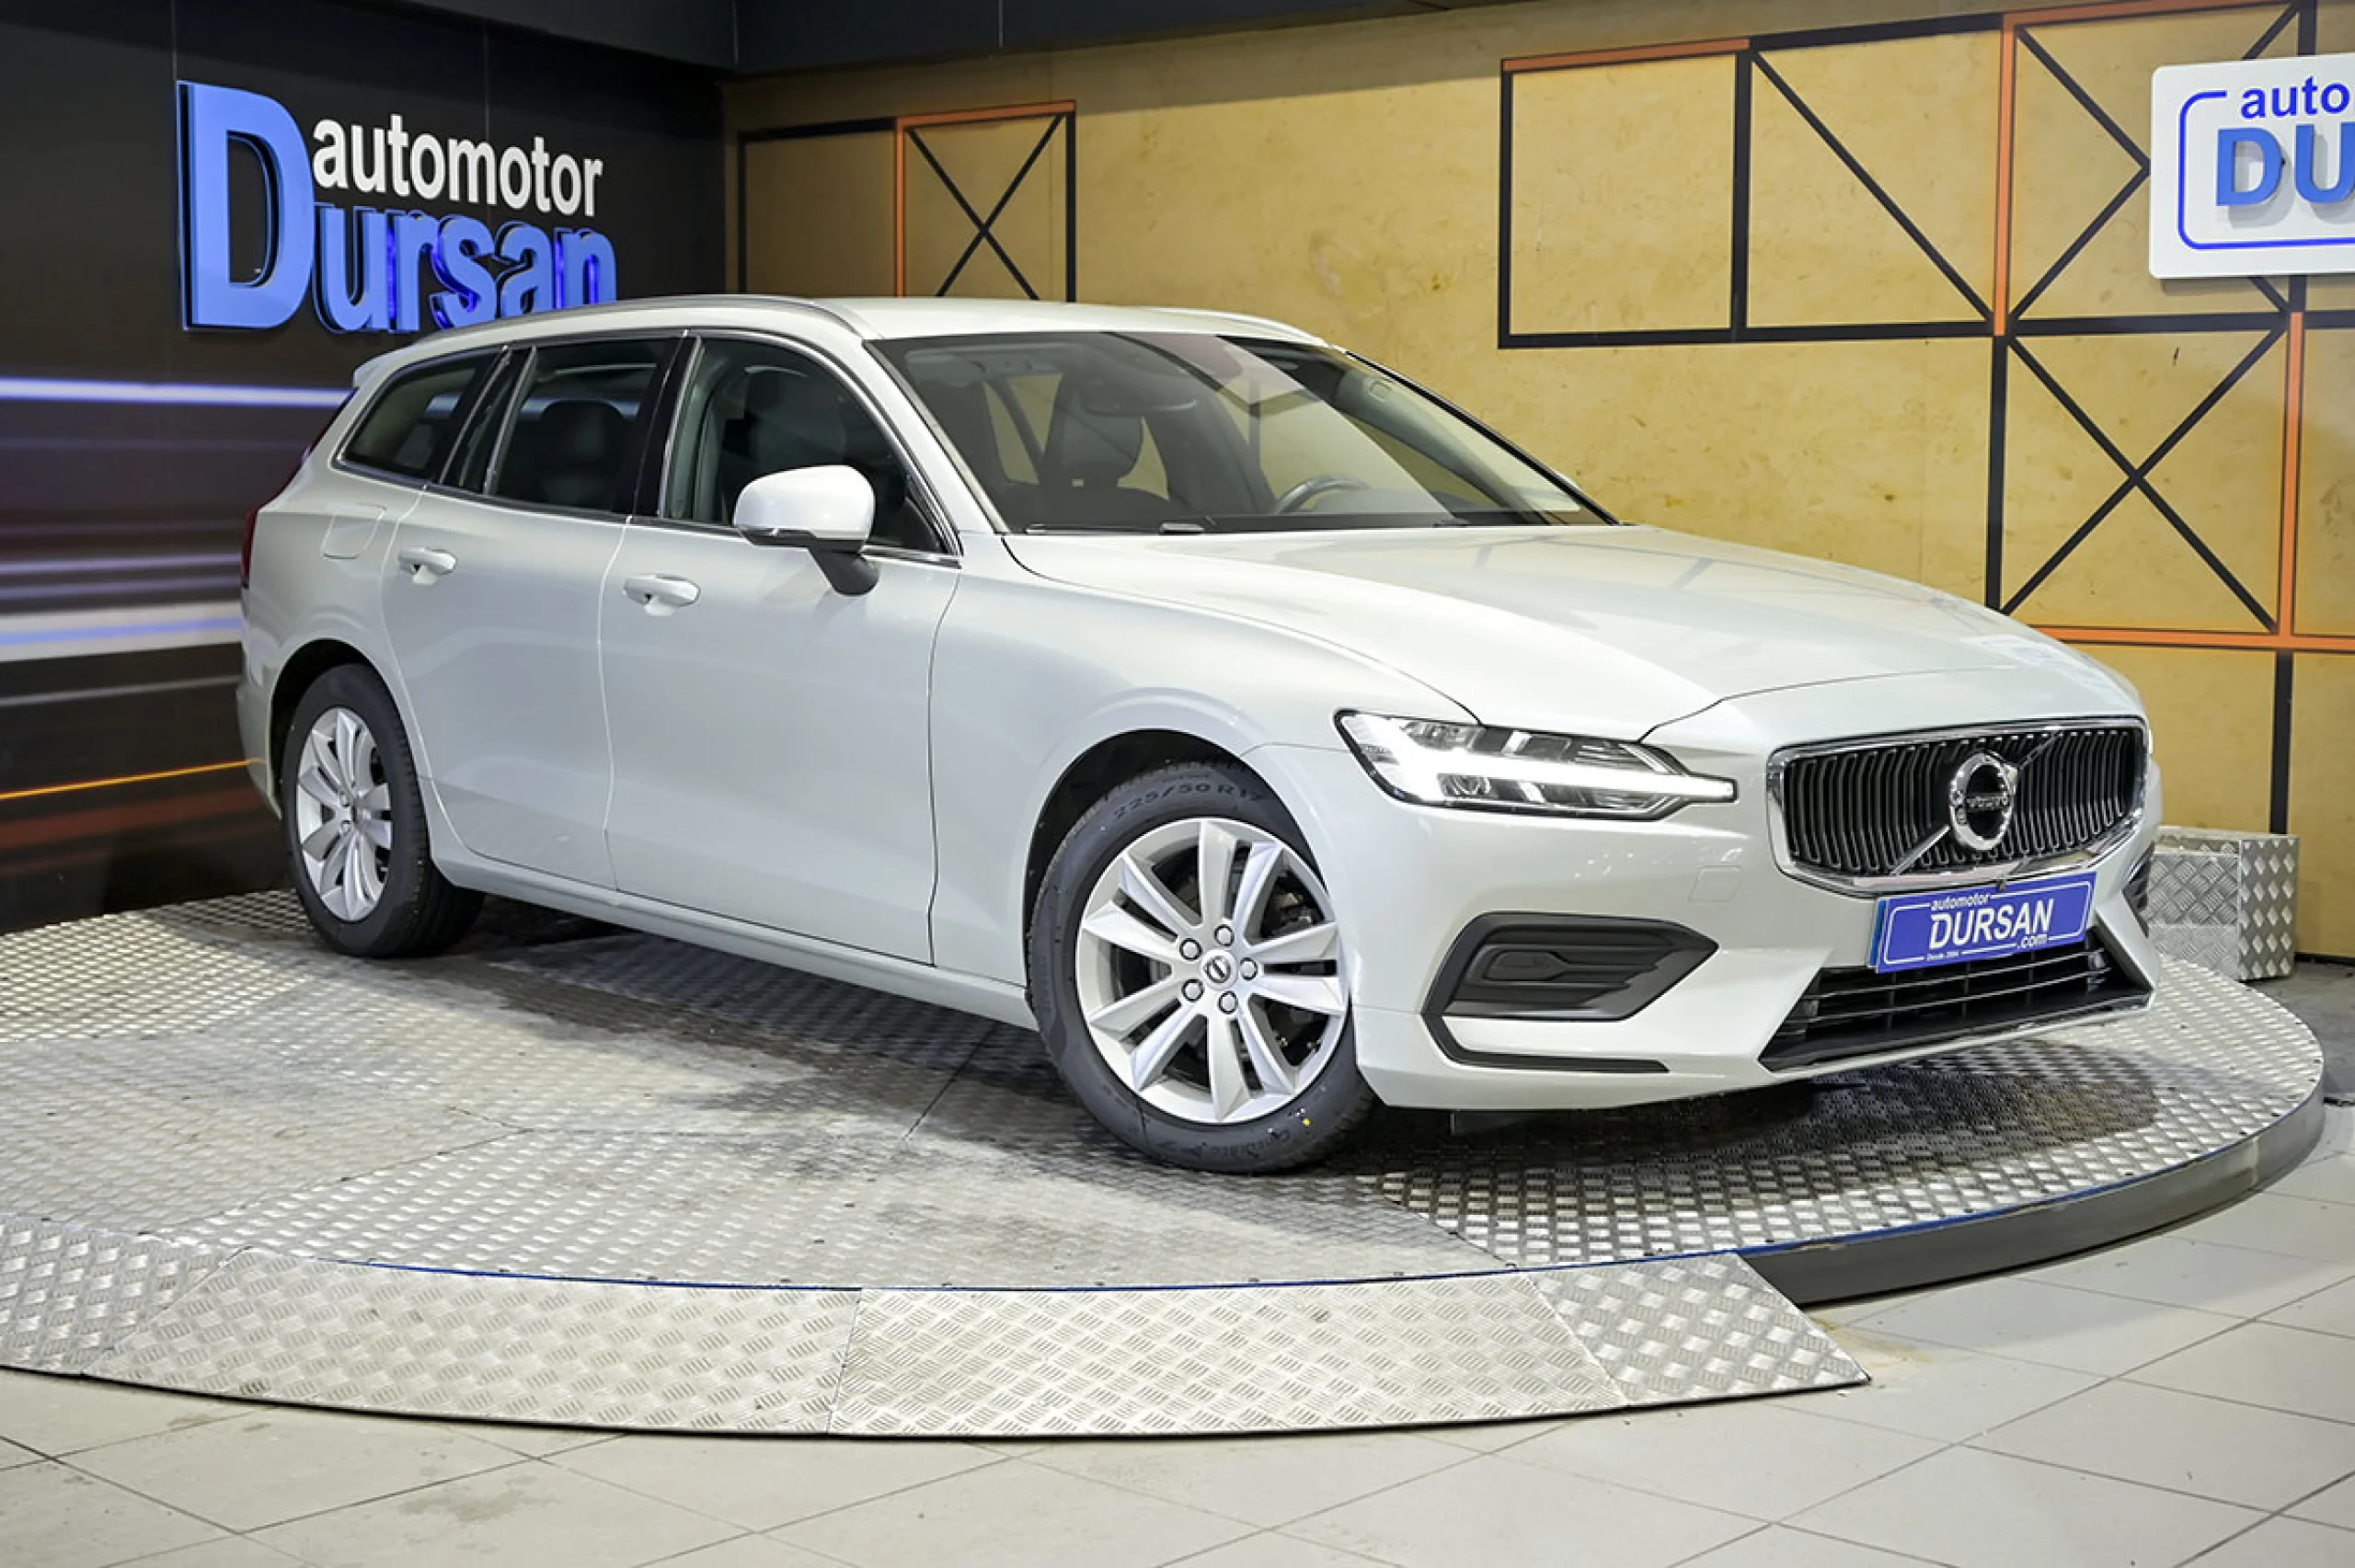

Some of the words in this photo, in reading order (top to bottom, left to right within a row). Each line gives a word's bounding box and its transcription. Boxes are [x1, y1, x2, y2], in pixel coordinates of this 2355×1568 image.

[314, 114, 603, 216] automotor
[2216, 121, 2355, 205] DU
[178, 80, 617, 332] Dursan
[1928, 898, 2054, 950] DURSAN
[1931, 893, 1990, 911] automotor
